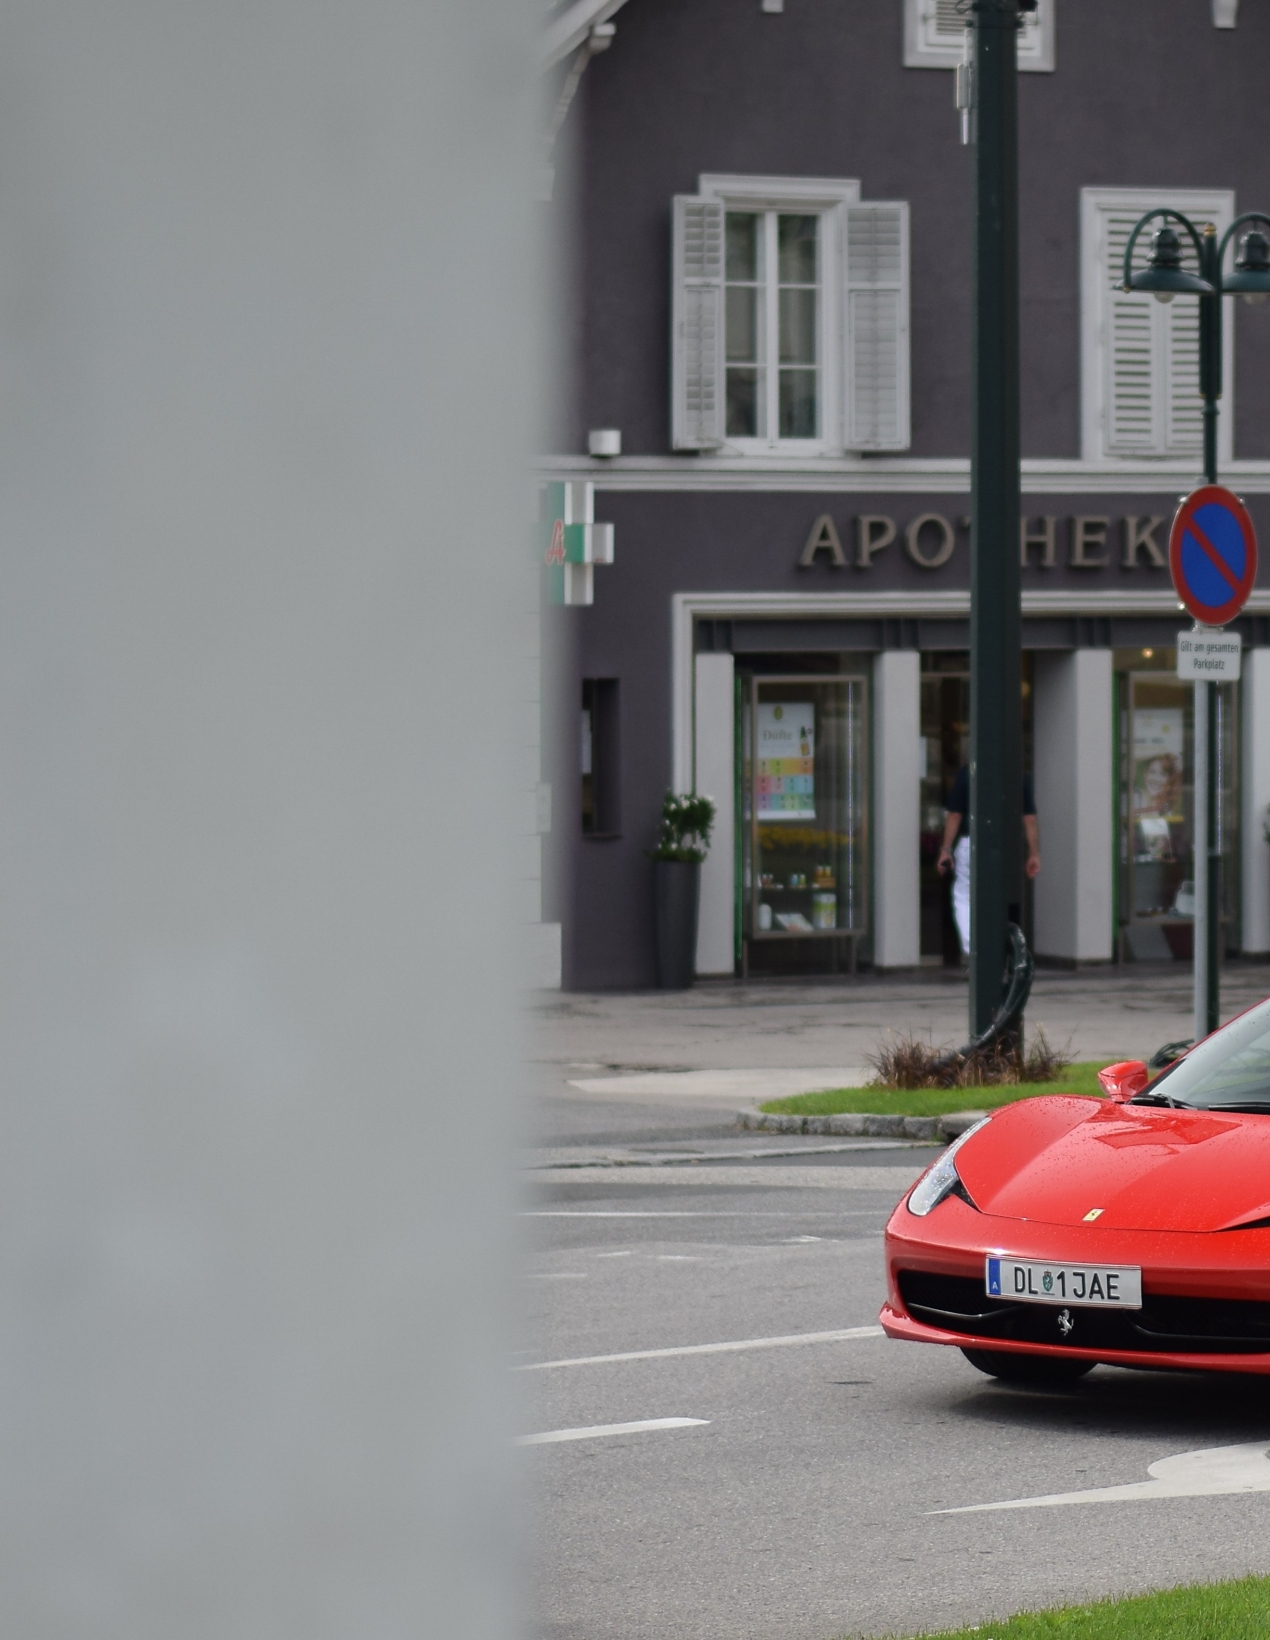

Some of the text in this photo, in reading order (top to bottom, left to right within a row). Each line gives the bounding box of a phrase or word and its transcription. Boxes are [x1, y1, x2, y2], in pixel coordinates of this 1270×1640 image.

[799, 512, 1170, 569] APOHEK
[1181, 640, 1239, 655] Gilt am gesamten
[1194, 658, 1225, 671] Parkplatz
[1014, 1266, 1038, 1294] DL
